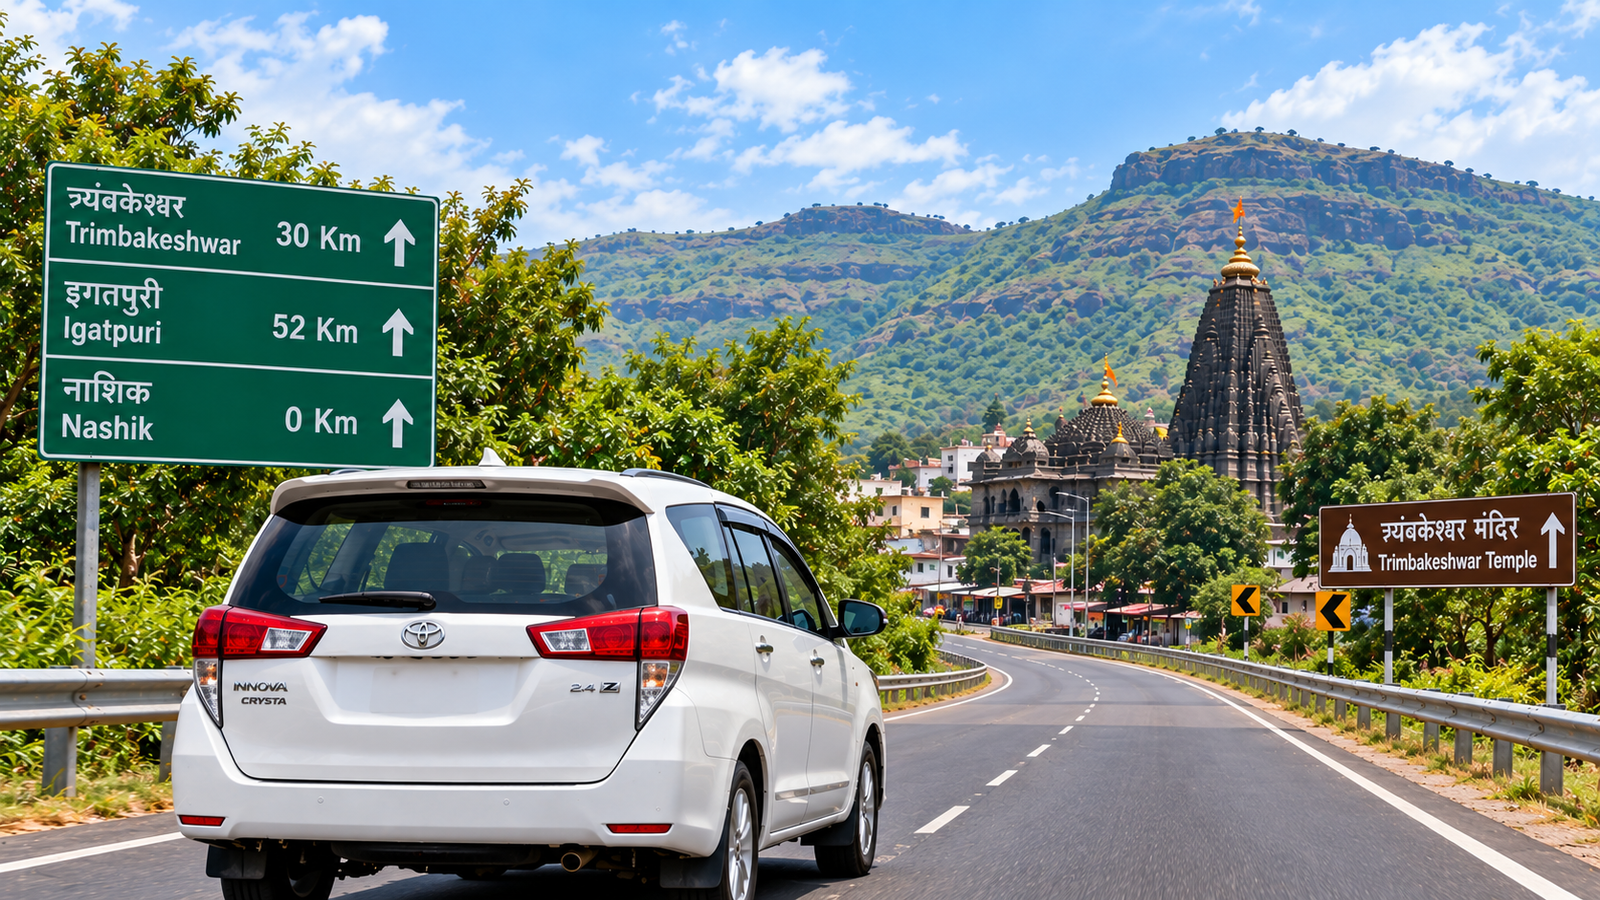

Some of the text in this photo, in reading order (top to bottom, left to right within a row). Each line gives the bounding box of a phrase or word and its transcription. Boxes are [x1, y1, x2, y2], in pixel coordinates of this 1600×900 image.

[65, 220, 361, 256] Trimbakeshwar 30 Km
[64, 277, 164, 317] इगतपुरी
[63, 313, 358, 348] Igatpuri 52 Km
[61, 370, 153, 405] नाशिक
[62, 406, 358, 441] Nashik 0 Km
[1472, 509, 1520, 541] मंदिर
[1377, 549, 1538, 574] Trimbakeshwar Temple
[233, 681, 288, 692] INNOVA
[241, 697, 287, 705] CRYSTA
[569, 682, 619, 693] 2.4 Z
